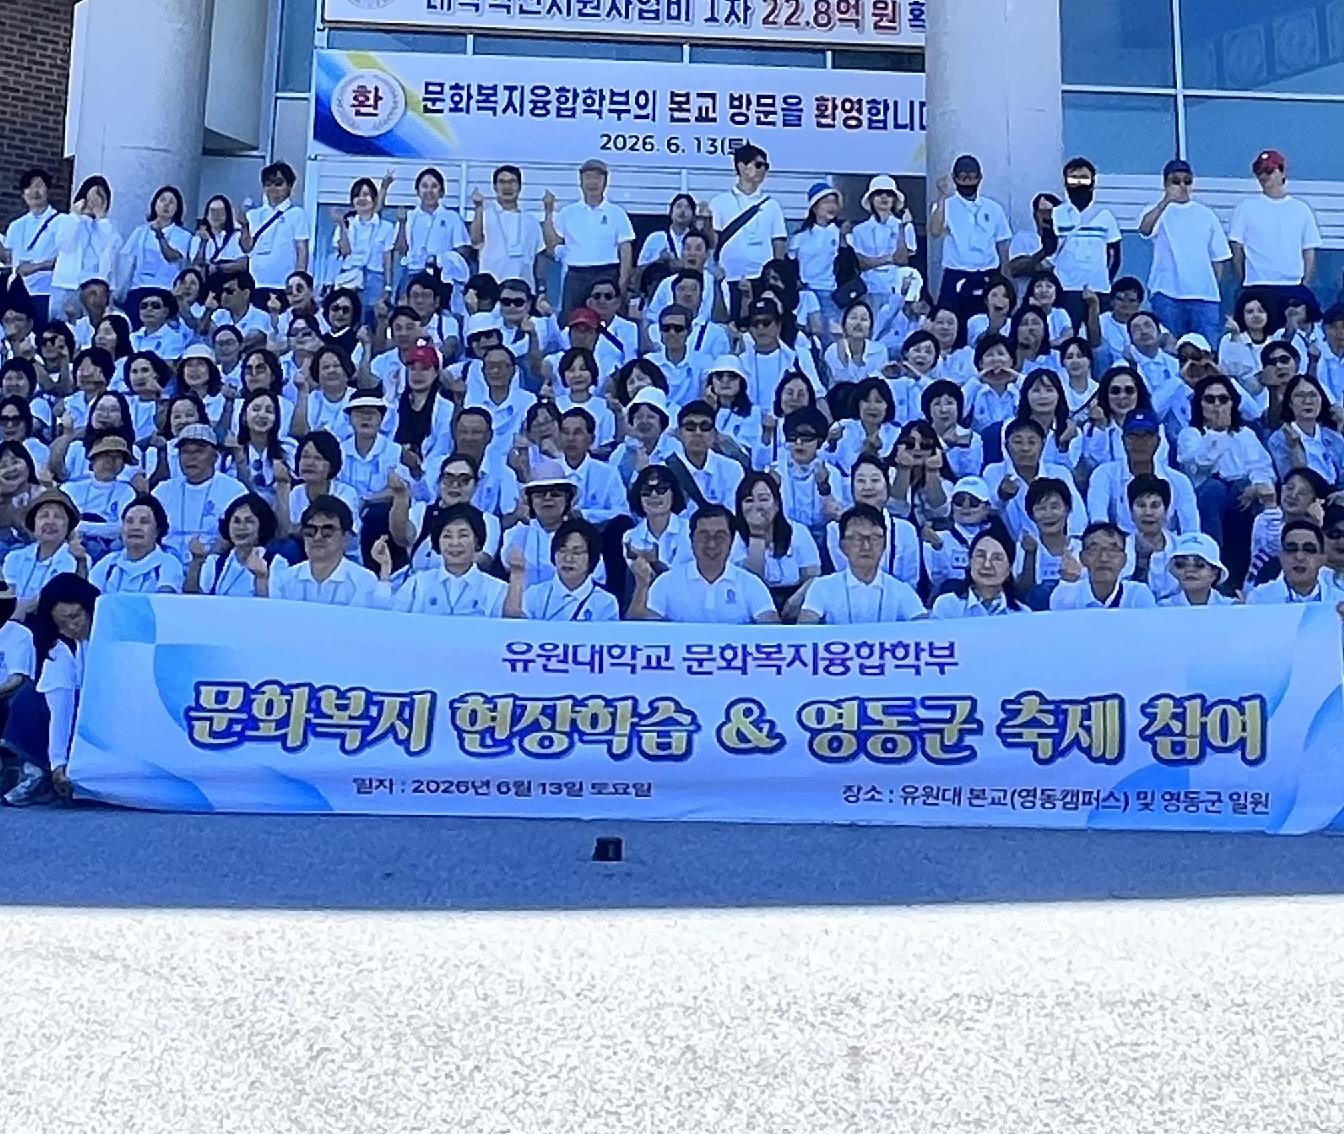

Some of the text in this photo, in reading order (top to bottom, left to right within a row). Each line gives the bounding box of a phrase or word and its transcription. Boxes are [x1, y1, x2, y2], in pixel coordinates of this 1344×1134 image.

[350, 85, 383, 117] 환
[422, 81, 657, 123] 문화복지융합학부의
[668, 91, 718, 123] 본교
[729, 93, 804, 128] 방문을
[600, 133, 750, 156] 2026. 6. 13(토
[502, 641, 959, 676] 유원대학교 문화복지융합학부
[185, 680, 1268, 766] 문화복지 현장학습 & 영동군 축제 참여
[496, 780, 533, 798] 6월
[537, 782, 584, 798] 13일
[589, 782, 653, 798] 토요일
[842, 784, 885, 805] 장소
[900, 785, 962, 807] 유원대
[966, 787, 1130, 812] 본교(영동캠퍼스)
[1136, 790, 1156, 812] 및
[1160, 790, 1225, 813] 영동군
[1229, 791, 1271, 815] 일원
